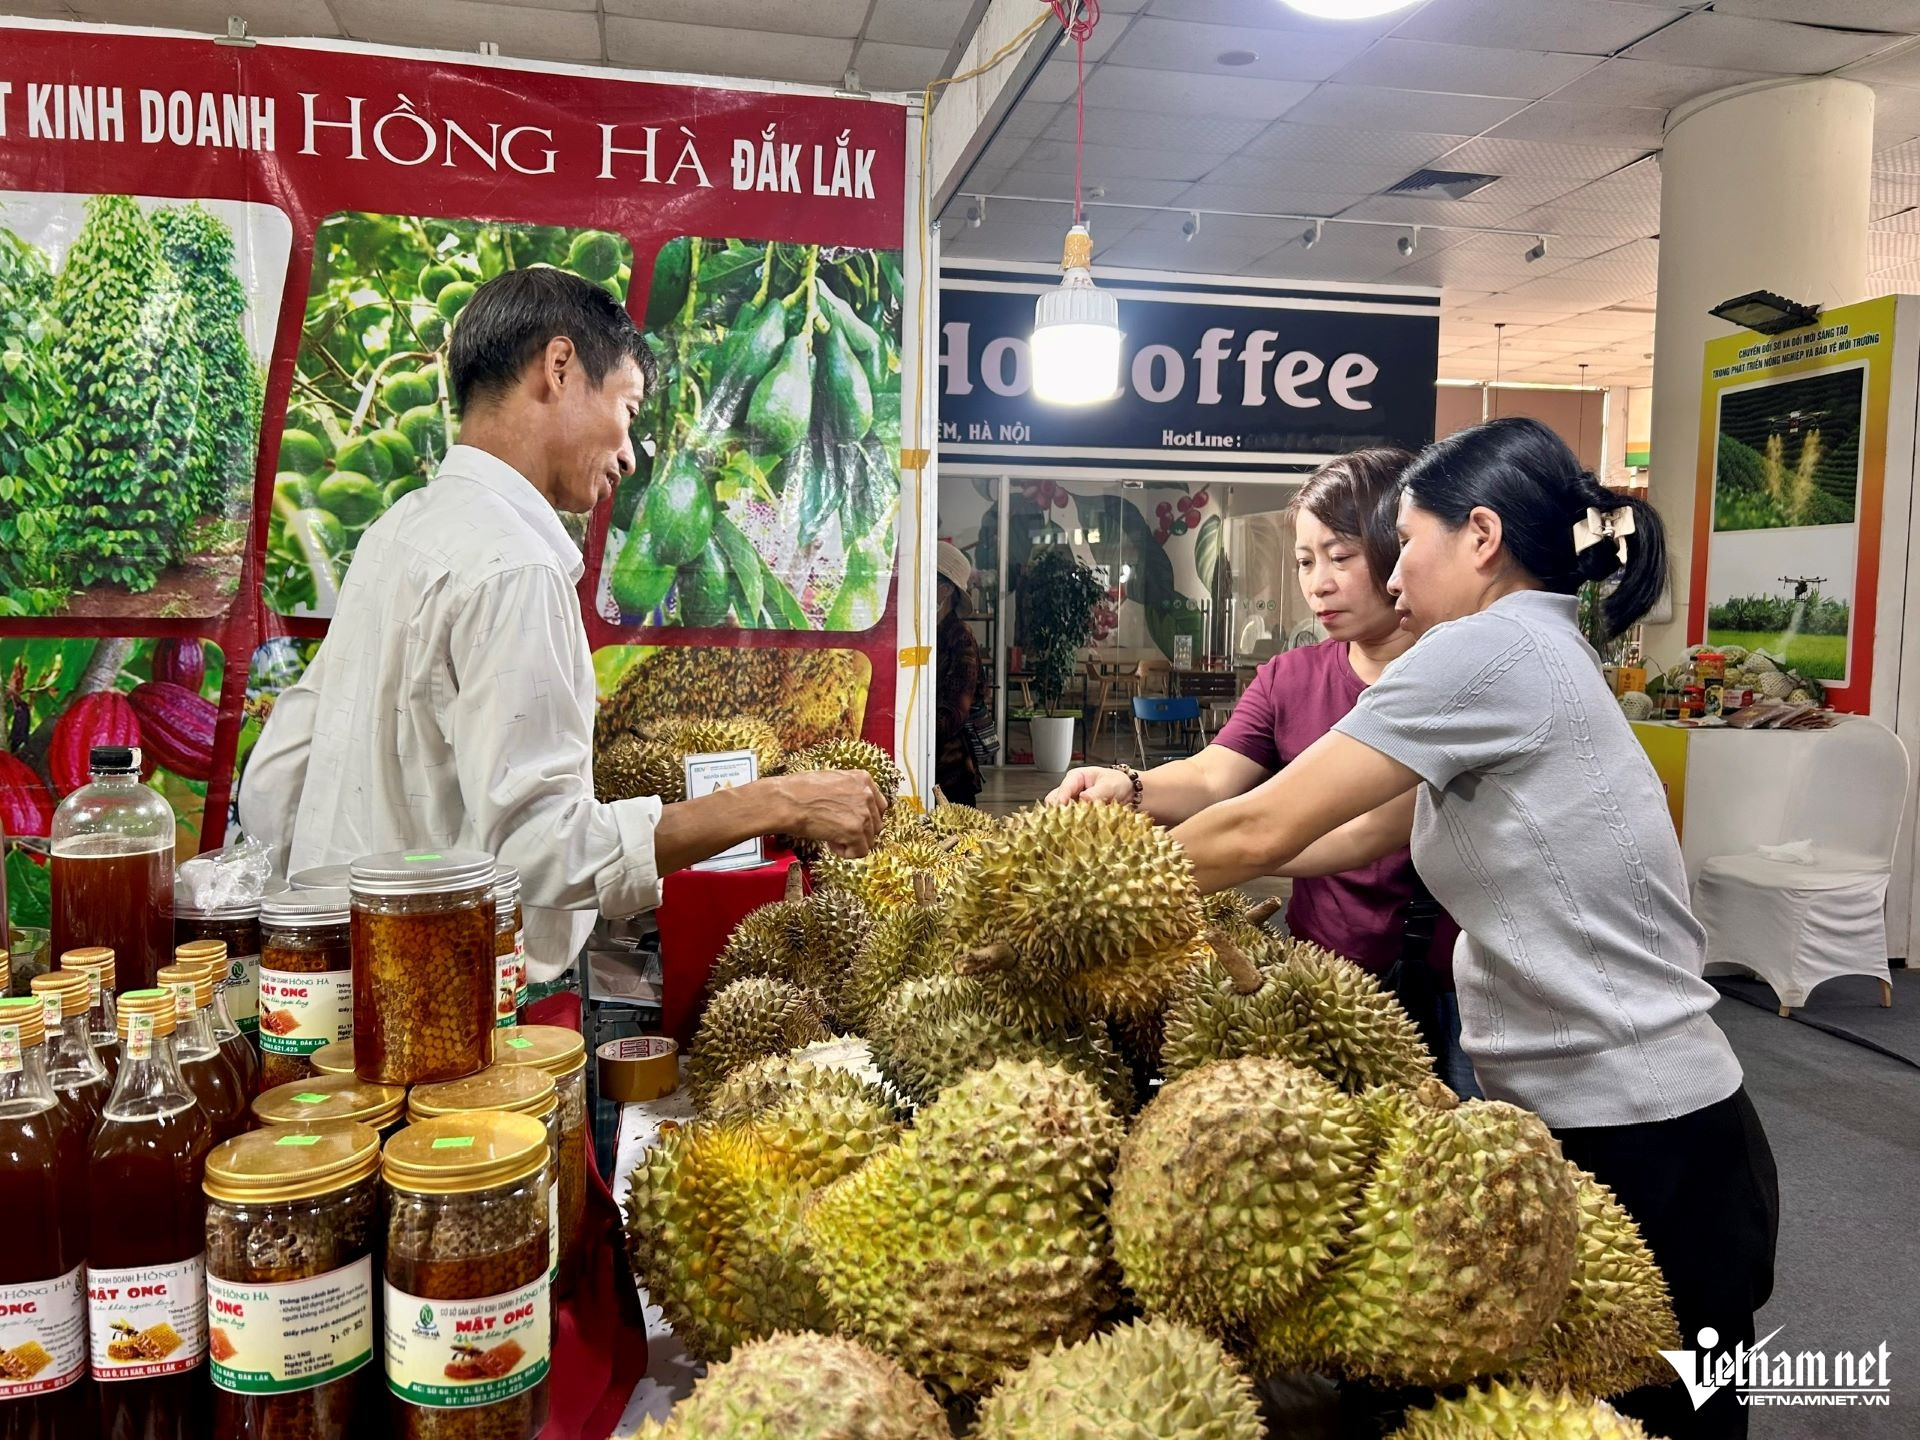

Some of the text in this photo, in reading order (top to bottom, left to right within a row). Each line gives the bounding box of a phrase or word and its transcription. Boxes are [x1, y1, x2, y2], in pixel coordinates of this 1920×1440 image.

[27, 83, 125, 143] KINH
[140, 90, 275, 151] DOANH
[297, 92, 560, 175] HỒNG
[596, 123, 714, 188] HÀ
[731, 123, 801, 194] ĐẮK
[813, 128, 876, 199] LẮK
[1817, 327, 1834, 340] SÁNG
[1836, 325, 1848, 338] TẠO
[1713, 367, 1730, 378] TRONG
[1731, 362, 1745, 374] PHÁT
[1764, 356, 1780, 368] NÔNG
[1805, 348, 1813, 358] VÀ
[1838, 339, 1851, 351] MÔI
[1853, 333, 1880, 348] TRƯỜNG
[969, 420, 993, 440] HÀ
[1000, 421, 1031, 444] NỘI
[281, 987, 308, 997] ONG
[113, 1275, 134, 1283] DOANH
[136, 1270, 177, 1282] HỒNG
[88, 1284, 167, 1302] MẬT ONG
[216, 1299, 244, 1317] ONG
[456, 1303, 534, 1333] MẬT ONG
